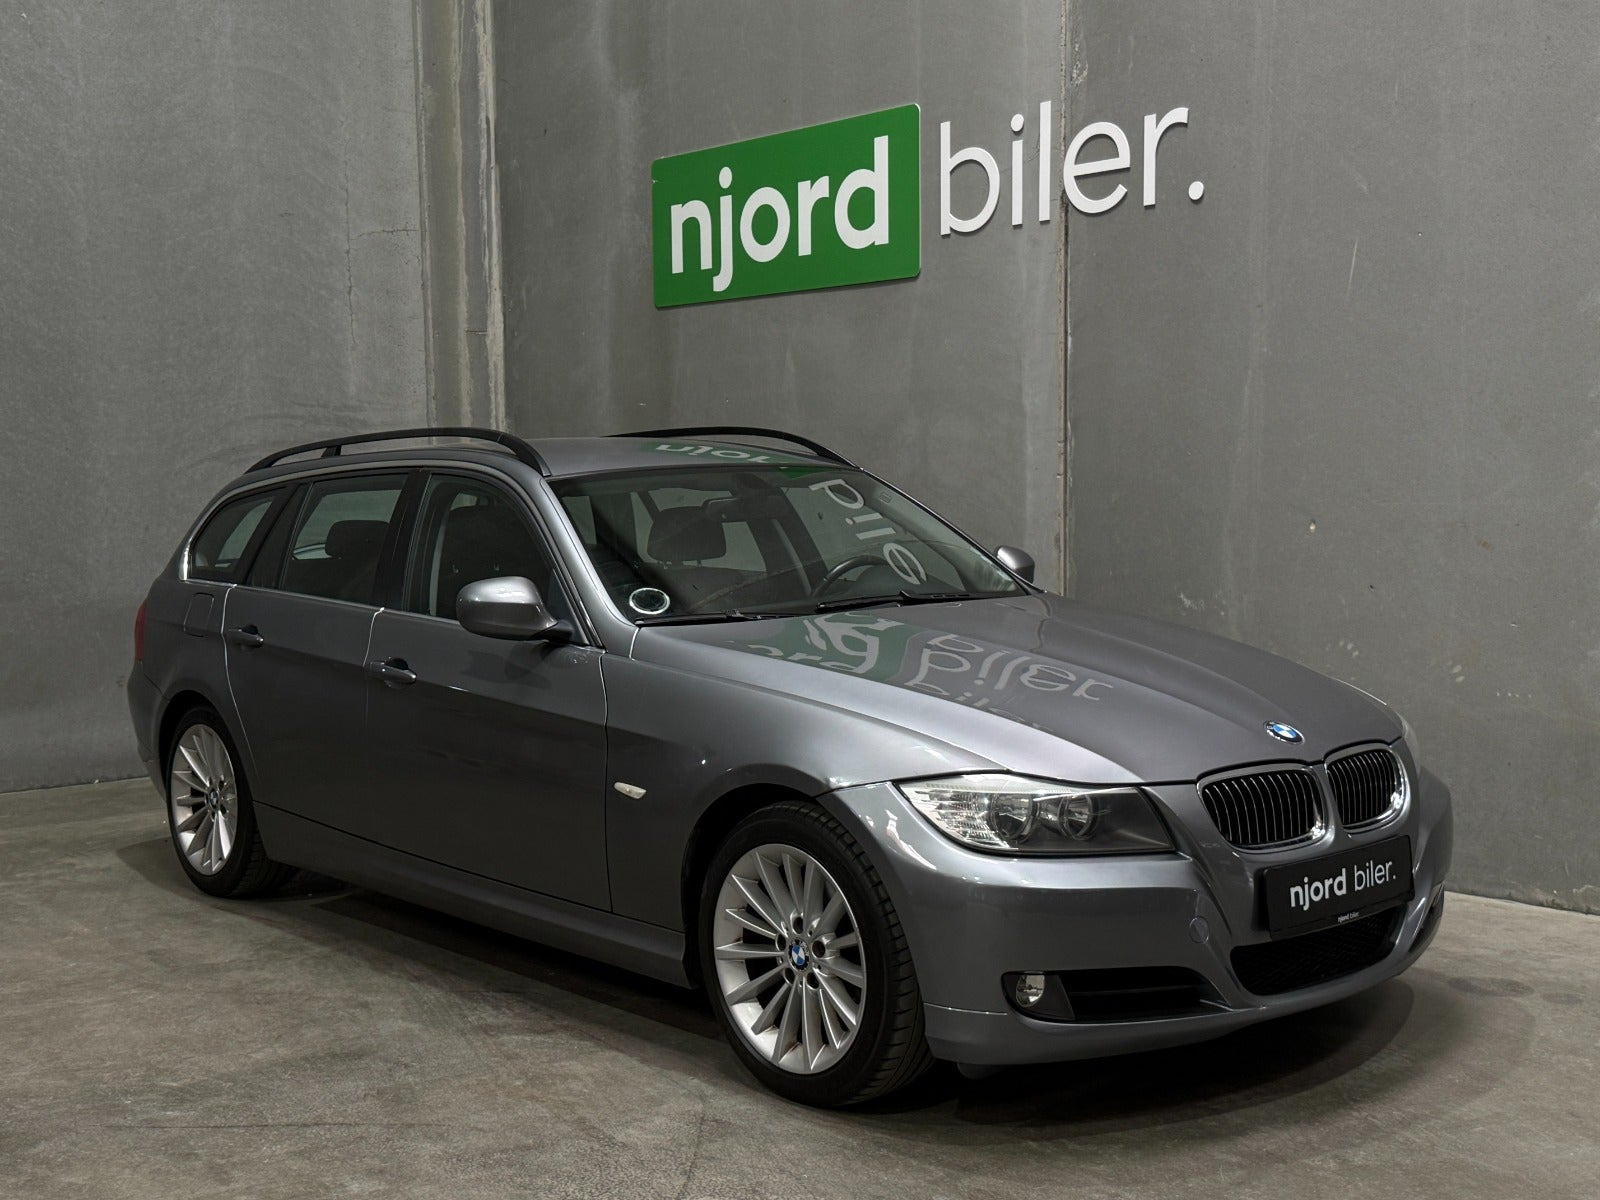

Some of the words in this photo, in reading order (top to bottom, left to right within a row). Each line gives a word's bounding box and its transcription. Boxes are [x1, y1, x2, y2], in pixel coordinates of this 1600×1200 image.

[670, 135, 889, 292] njord
[939, 101, 1204, 236] biler.
[1290, 867, 1347, 911] njord
[1354, 860, 1396, 892] biler.
